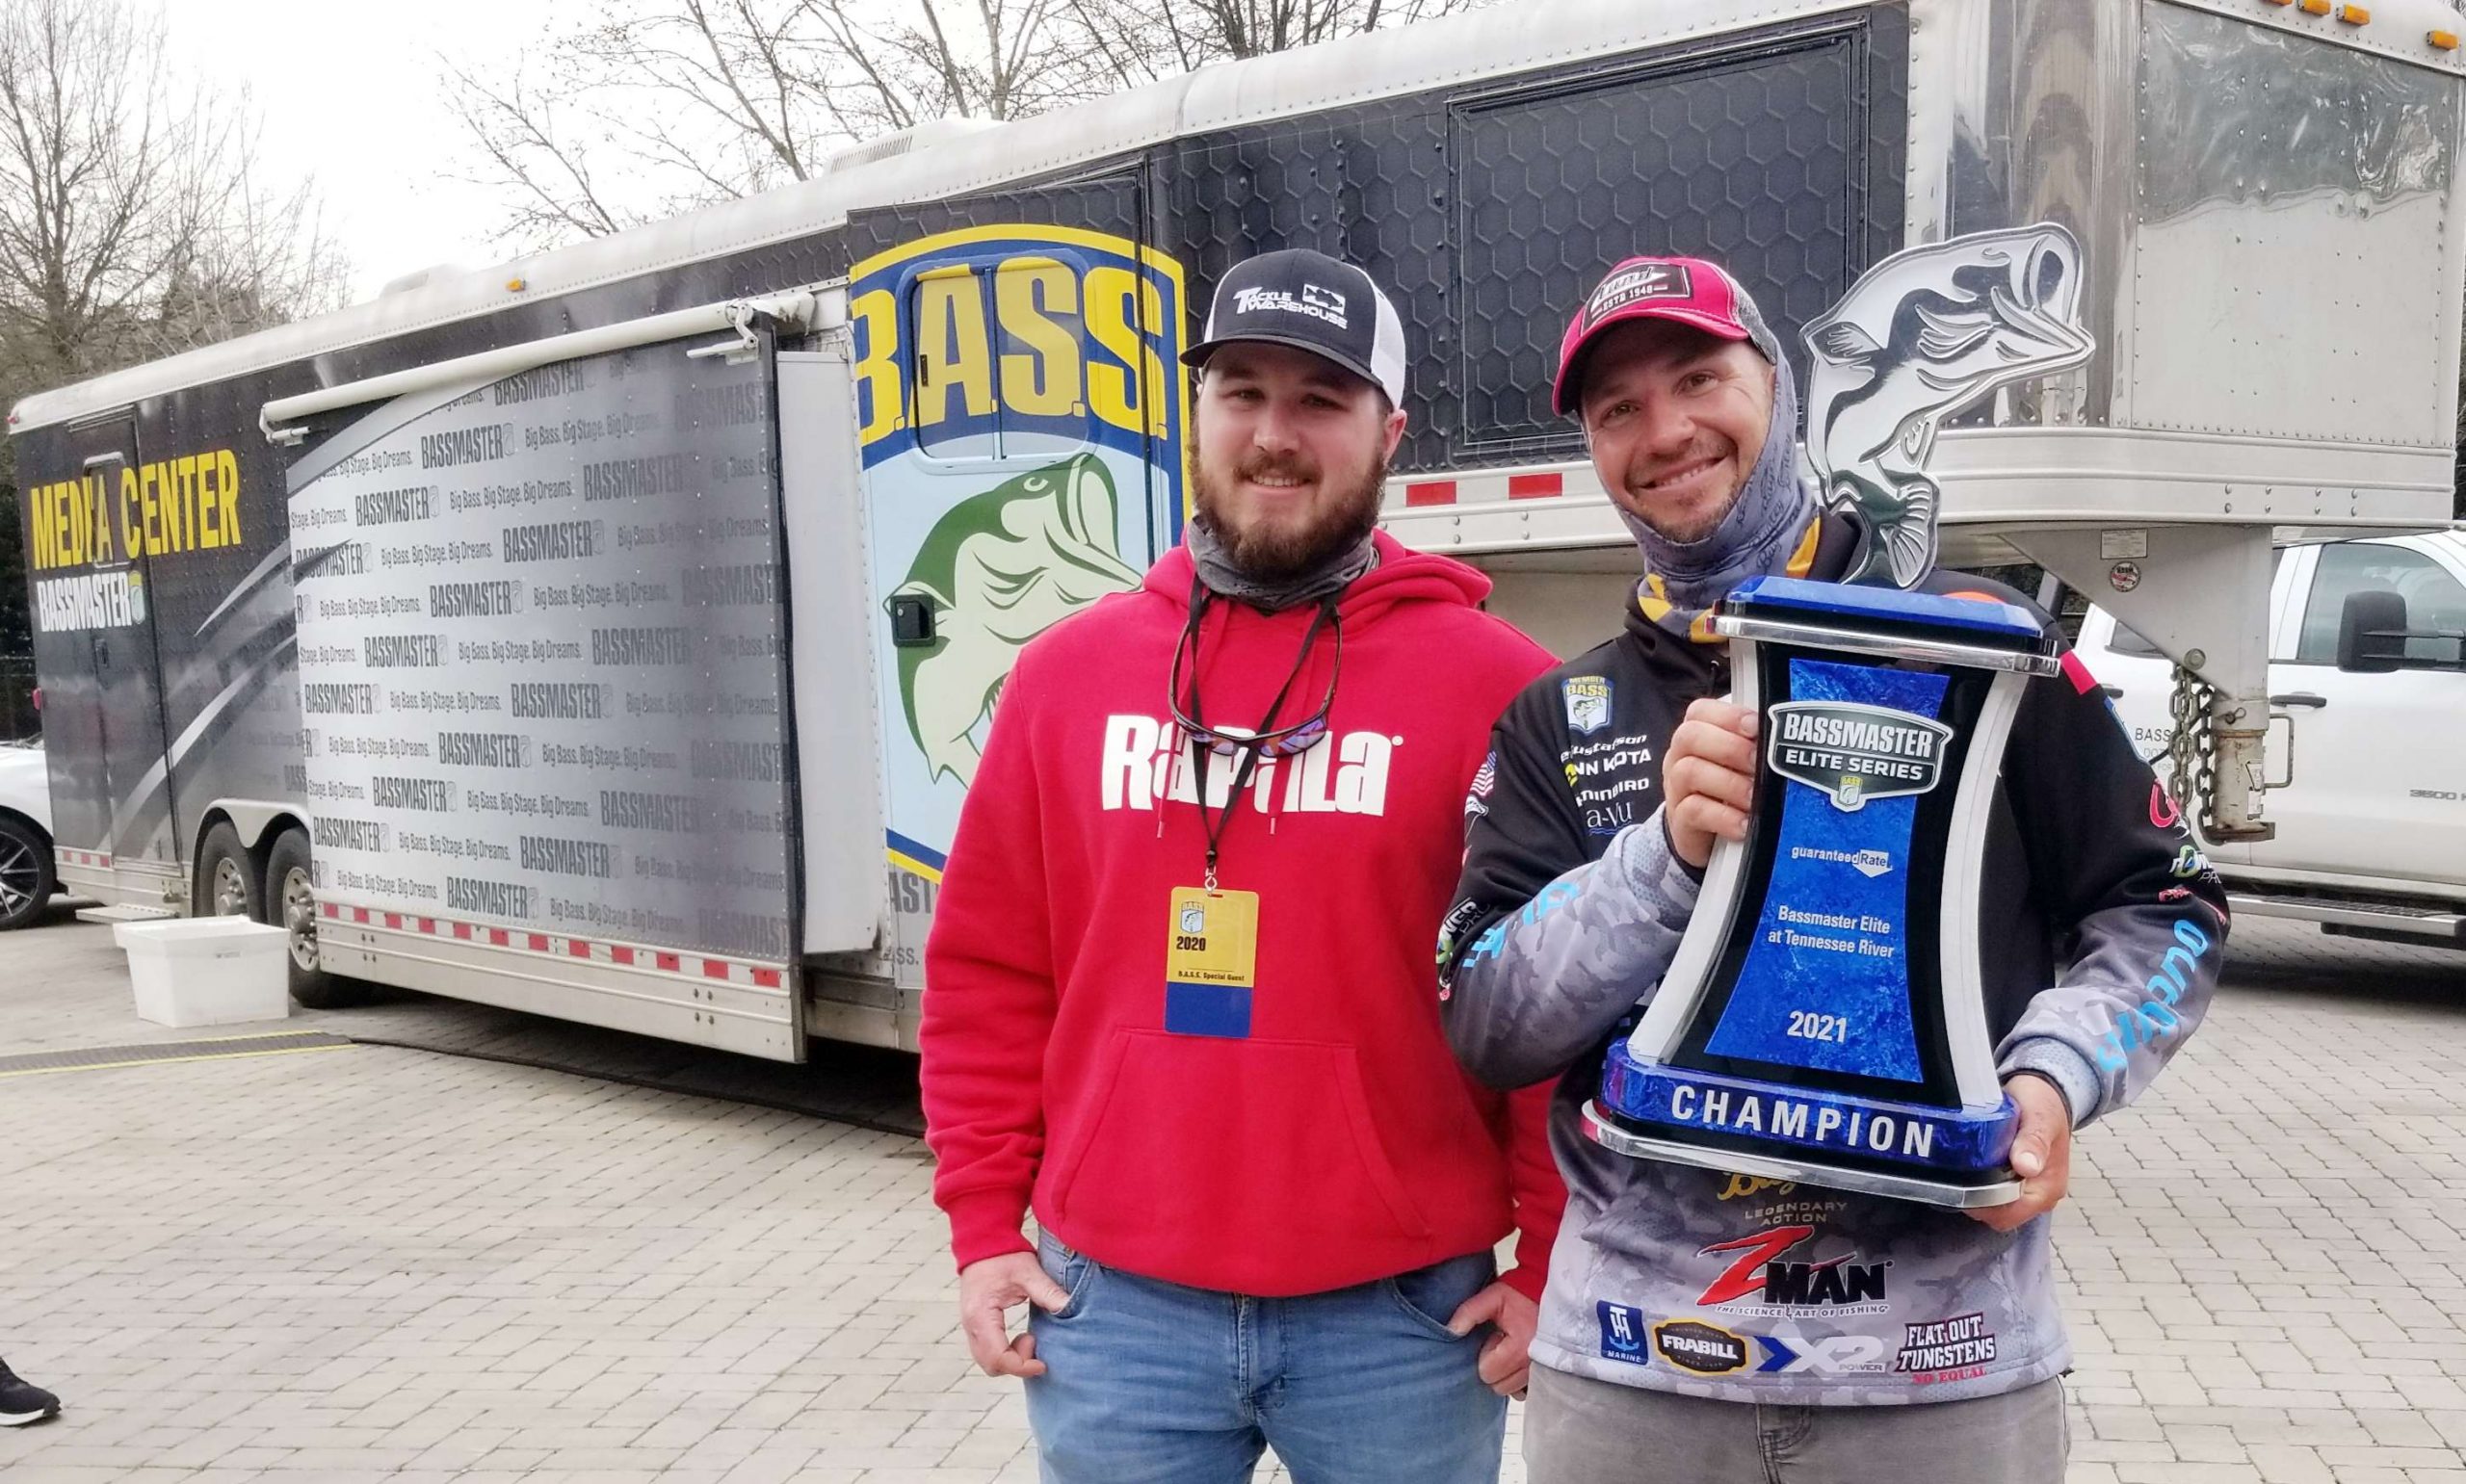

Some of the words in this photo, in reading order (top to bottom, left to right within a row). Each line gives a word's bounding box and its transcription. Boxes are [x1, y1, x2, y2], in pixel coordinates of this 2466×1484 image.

[1233, 287, 1293, 314] TACKLE
[1248, 299, 1348, 329] WAREHOUSE
[421, 424, 502, 469] BASSMASTER
[525, 426, 538, 452] Big
[539, 422, 561, 445] Bass.
[564, 419, 577, 446] Big
[578, 415, 604, 443] Stage.
[30, 474, 113, 570] MEDIA
[119, 449, 241, 560] CENTER
[355, 486, 429, 527] BASSMASTER
[449, 489, 461, 513] Big
[462, 487, 482, 508] Bass.
[484, 485, 496, 509] Big
[497, 482, 521, 508] Stage.
[524, 480, 537, 505] Big
[538, 475, 572, 499] Dreams.
[381, 547, 392, 569] Big
[393, 545, 410, 564] Bass.
[412, 544, 424, 567] Big
[425, 542, 446, 566] Stage.
[449, 540, 460, 564] Big
[462, 537, 493, 559] Dreams.
[503, 520, 592, 562] BASSMASTER
[37, 572, 132, 632] BASSMASTER
[320, 599, 329, 620] Big
[330, 598, 346, 615] Bass.
[348, 598, 358, 619] Big
[359, 596, 379, 618] Stage.
[380, 595, 392, 617] Big
[393, 593, 421, 612] Dreams.
[431, 581, 511, 617] BASSMASTER
[534, 586, 546, 610] Big
[547, 585, 568, 605] Bass.
[571, 584, 586, 609] Big
[364, 636, 438, 667] BASSMASTER
[458, 641, 470, 664] Big
[471, 640, 490, 659] Bass.
[492, 640, 505, 663] Big
[506, 639, 529, 663] Stage.
[532, 638, 545, 663] Big
[547, 638, 581, 658] Dreams.
[304, 684, 372, 714] BASSMASTER
[390, 690, 401, 712] Big
[402, 690, 419, 708] Bass.
[421, 690, 433, 713] Big
[433, 690, 455, 713] Stage.
[458, 690, 469, 713] Big
[471, 691, 502, 710] Dreams.
[512, 684, 600, 718] BASSMASTER
[328, 736, 339, 756] Big
[339, 736, 355, 753] Bass.
[357, 737, 368, 757] Big
[368, 737, 387, 758] Stage.
[390, 738, 401, 759] Big
[402, 738, 430, 756] Dreams.
[439, 733, 519, 768] BASSMASTER
[541, 743, 555, 767] Big
[556, 743, 577, 763] Bass.
[1783, 713, 1933, 758] BASSMASTER
[1603, 748, 1652, 772] KOTA
[1785, 749, 1842, 769] ELITE
[1848, 756, 1923, 780] SERIES
[373, 777, 447, 812] BASSMASTER
[466, 790, 479, 812] Big
[480, 791, 499, 809] Bass.
[501, 792, 513, 815] Big
[514, 793, 538, 817] Stage.
[540, 794, 554, 818] Big
[556, 795, 590, 817] Dreams.
[313, 817, 380, 852] BASSMASTER
[399, 831, 409, 853] Big
[410, 832, 428, 851] Bass.
[430, 834, 441, 856] Big
[442, 835, 463, 859] Stage.
[466, 838, 478, 861] Big
[480, 839, 510, 860] Dreams.
[520, 836, 609, 878] BASSMASTER
[1792, 846, 1859, 864] guaranteed
[337, 870, 348, 890] Big
[348, 871, 364, 889] Bass.
[366, 872, 377, 895] Big
[377, 874, 396, 898] Stage.
[399, 877, 409, 898] Big
[410, 878, 438, 899] Dreams.
[448, 876, 528, 919] BASSMASTER
[550, 897, 564, 921] Big
[564, 898, 585, 920] Bass.
[1778, 905, 1858, 930] Bassmaster
[1859, 915, 1891, 934] Elite
[1176, 935, 1206, 951] 2020
[1768, 930, 1782, 944] at
[1784, 929, 1855, 953] Tennessee
[1858, 939, 1895, 958] River
[1203, 972, 1226, 981] Special
[1787, 1010, 1848, 1043] 2021
[1671, 1084, 1934, 1159] CHAMPION
[1745, 1202, 1848, 1219] LEGENDARY
[1760, 1212, 1828, 1227] ACTION
[1763, 1261, 1888, 1306] MAN
[1738, 1306, 1782, 1316] SCIENCE
[1795, 1309, 1816, 1317] ART
[1840, 1305, 1886, 1316] FISHING
[1662, 1334, 1739, 1360] FRABILL
[1907, 1323, 1945, 1347] FLAT
[1948, 1315, 1982, 1341] OUT
[1607, 1349, 1641, 1363] MARINE
[1897, 1337, 1995, 1370] TUNGSTENS
